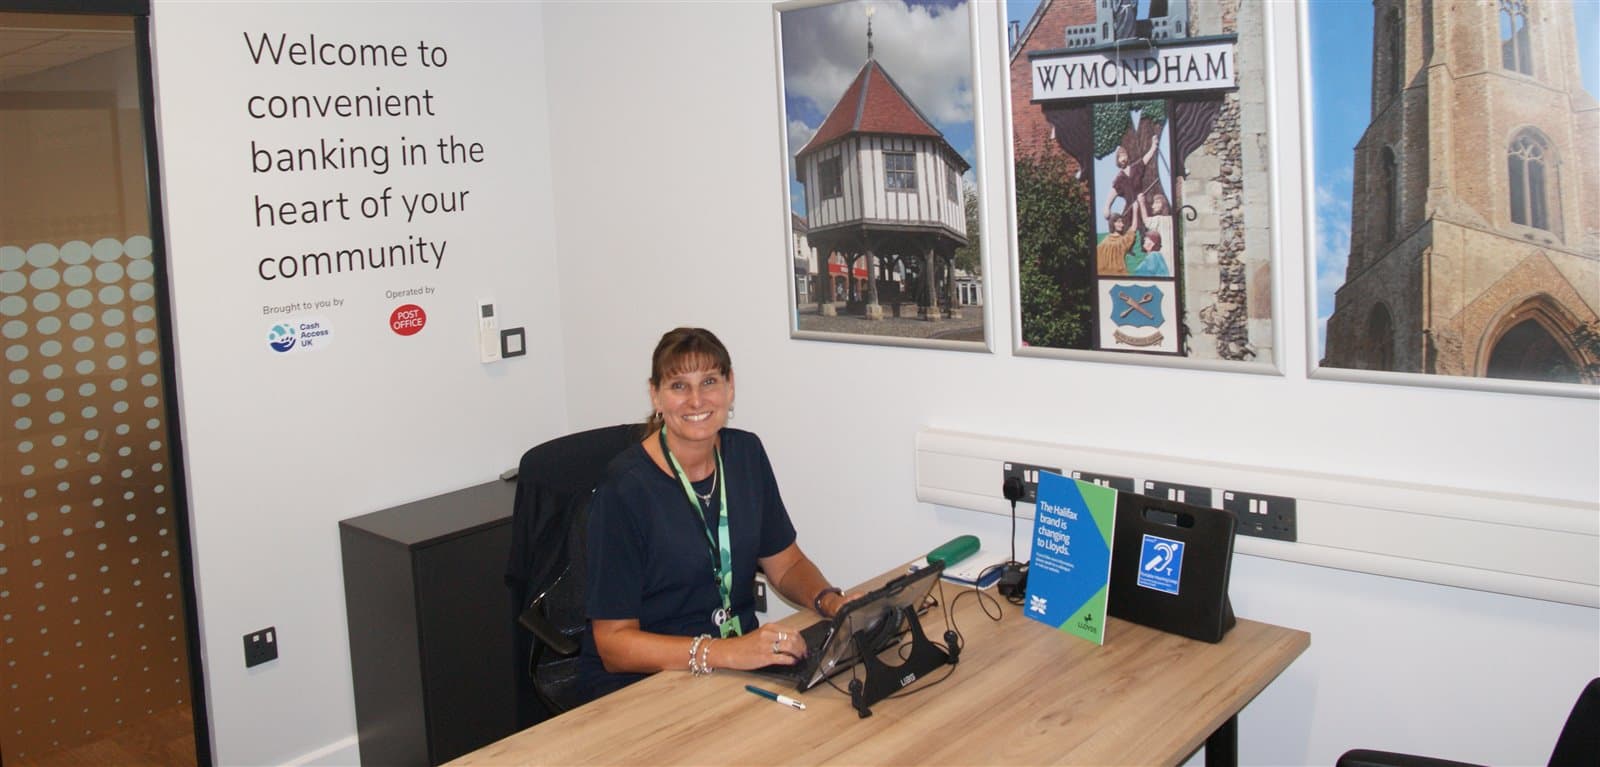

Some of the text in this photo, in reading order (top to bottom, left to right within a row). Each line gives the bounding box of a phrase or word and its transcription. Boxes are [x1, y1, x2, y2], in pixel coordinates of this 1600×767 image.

[243, 32, 448, 68] Welcome to
[1036, 51, 1229, 91] WYMONDHAM
[247, 87, 436, 119] convenient
[250, 134, 485, 175] banking in the
[254, 186, 470, 228] heart of your
[258, 235, 447, 281] community
[385, 285, 436, 300] Operated by
[263, 297, 345, 316] Brought to you by
[397, 310, 419, 320] POST
[299, 322, 320, 331] Cash
[393, 318, 423, 330] OFFICE
[300, 329, 329, 339] Access
[301, 339, 313, 348] UK
[1040, 501, 1078, 520] The Halifax
[1040, 512, 1068, 530] brand is
[1037, 537, 1045, 548] to
[1038, 525, 1071, 546] changing
